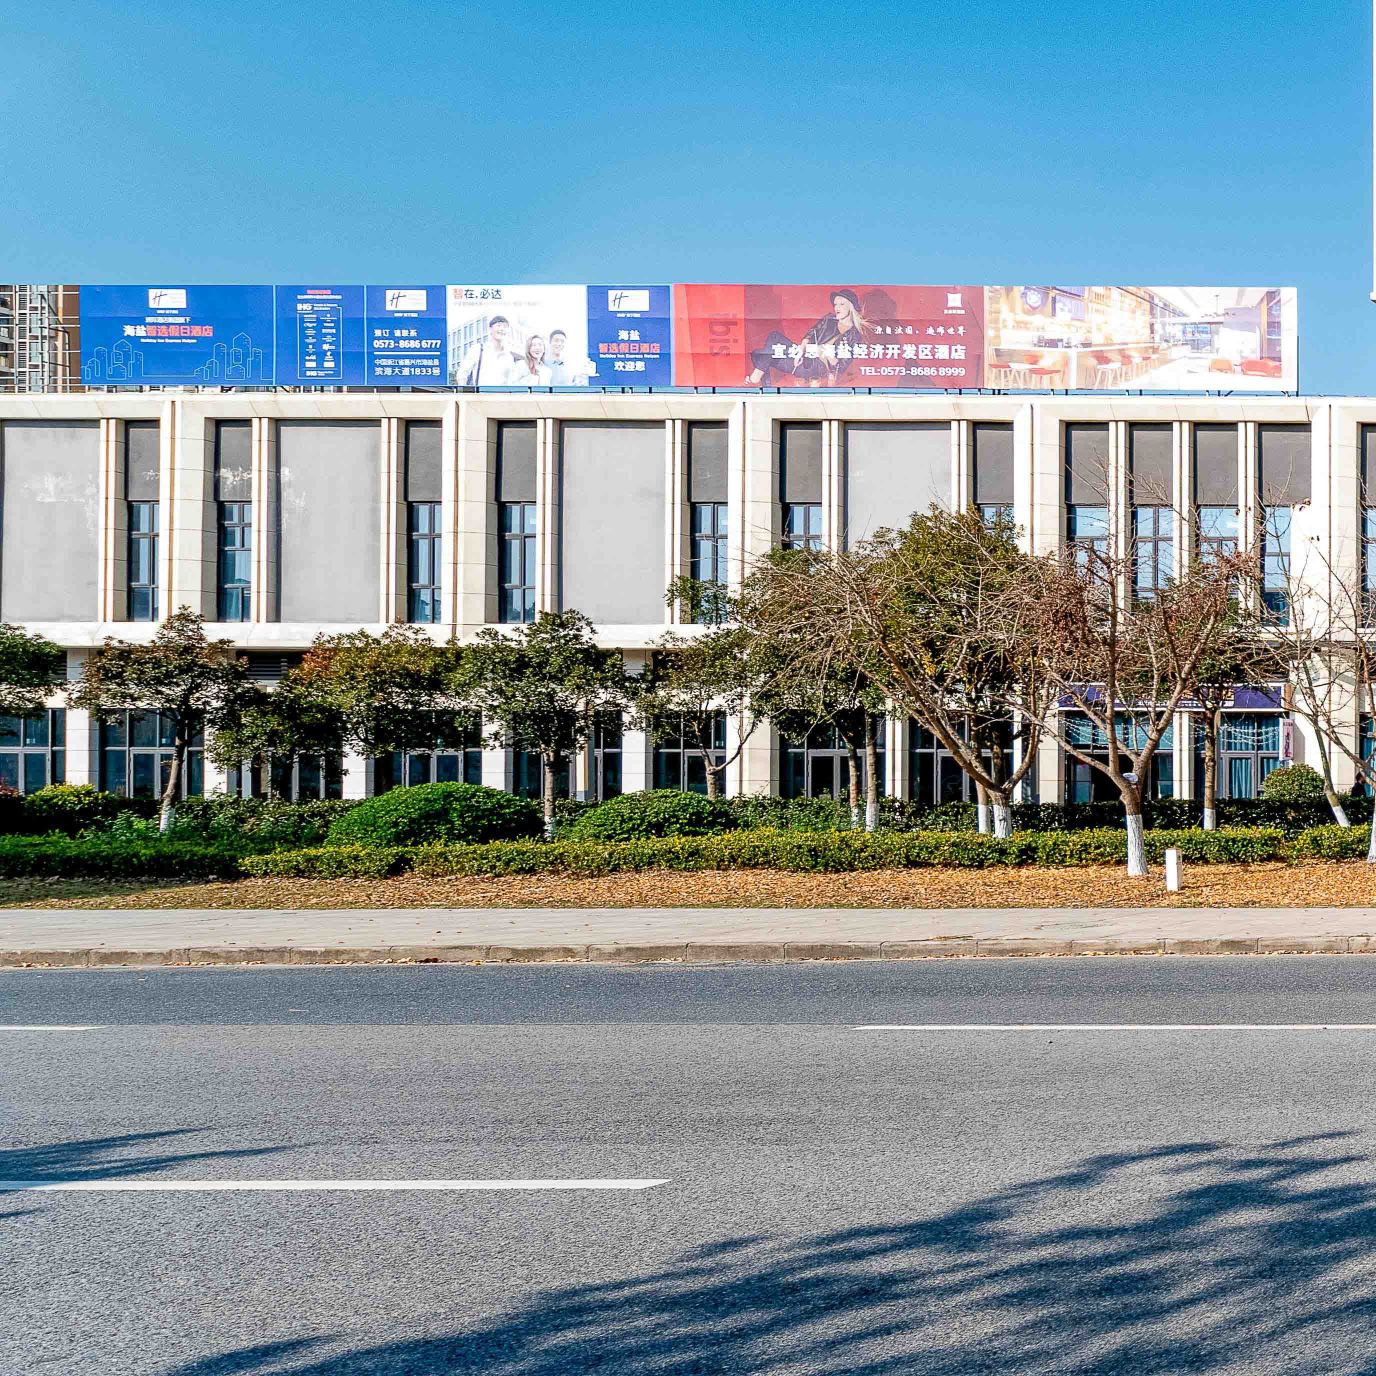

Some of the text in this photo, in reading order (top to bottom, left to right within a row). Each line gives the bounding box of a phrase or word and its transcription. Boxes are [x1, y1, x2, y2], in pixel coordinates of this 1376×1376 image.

[123, 324, 214, 337] 海盐智选假日酒店
[618, 329, 641, 341] 海盐
[708, 312, 738, 356] ibis
[373, 339, 441, 349] 0573-8686 6777
[599, 342, 660, 353] 智选假日酒店
[771, 343, 967, 360] 宜必思海盐经济开发区酒店
[613, 360, 646, 372] 欢迎您
[938, 367, 966, 377] 8999
